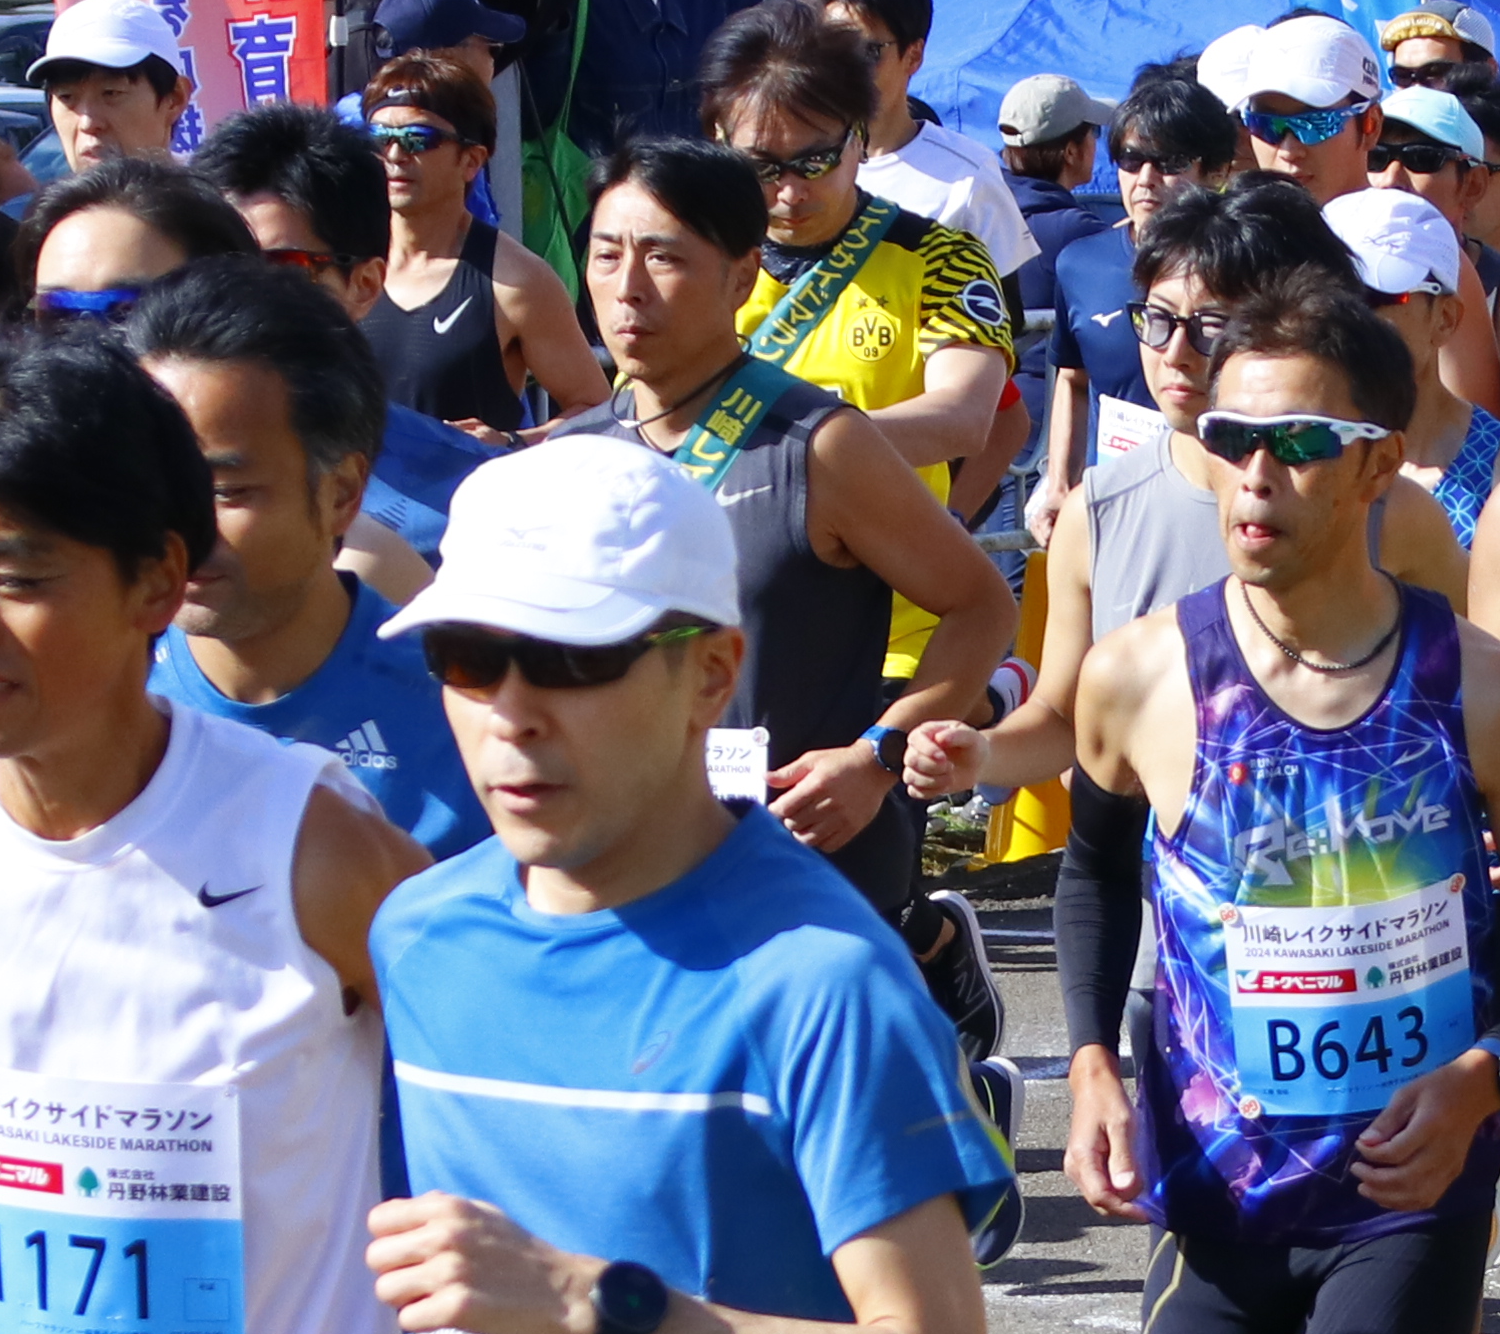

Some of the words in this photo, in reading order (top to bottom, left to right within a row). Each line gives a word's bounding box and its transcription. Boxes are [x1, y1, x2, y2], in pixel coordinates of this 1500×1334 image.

[853, 317, 891, 347] BVB
[1242, 899, 1448, 944] 川崎レイクサイドマラソン
[1245, 947, 1271, 958] 2024
[1273, 946, 1335, 959] KAWASAKI
[1337, 939, 1393, 957] LAKESIDE
[1395, 919, 1450, 948] MARATHON
[1389, 946, 1463, 985] 丹野林業建設
[1262, 975, 1344, 990] ヨークベニマル
[1267, 1006, 1428, 1083] B643
[43, 1131, 117, 1150] LAKESIDE
[120, 1137, 212, 1153] MARATHON
[107, 1168, 155, 1181] 株式会社
[107, 1182, 231, 1202] 丹野林業建設
